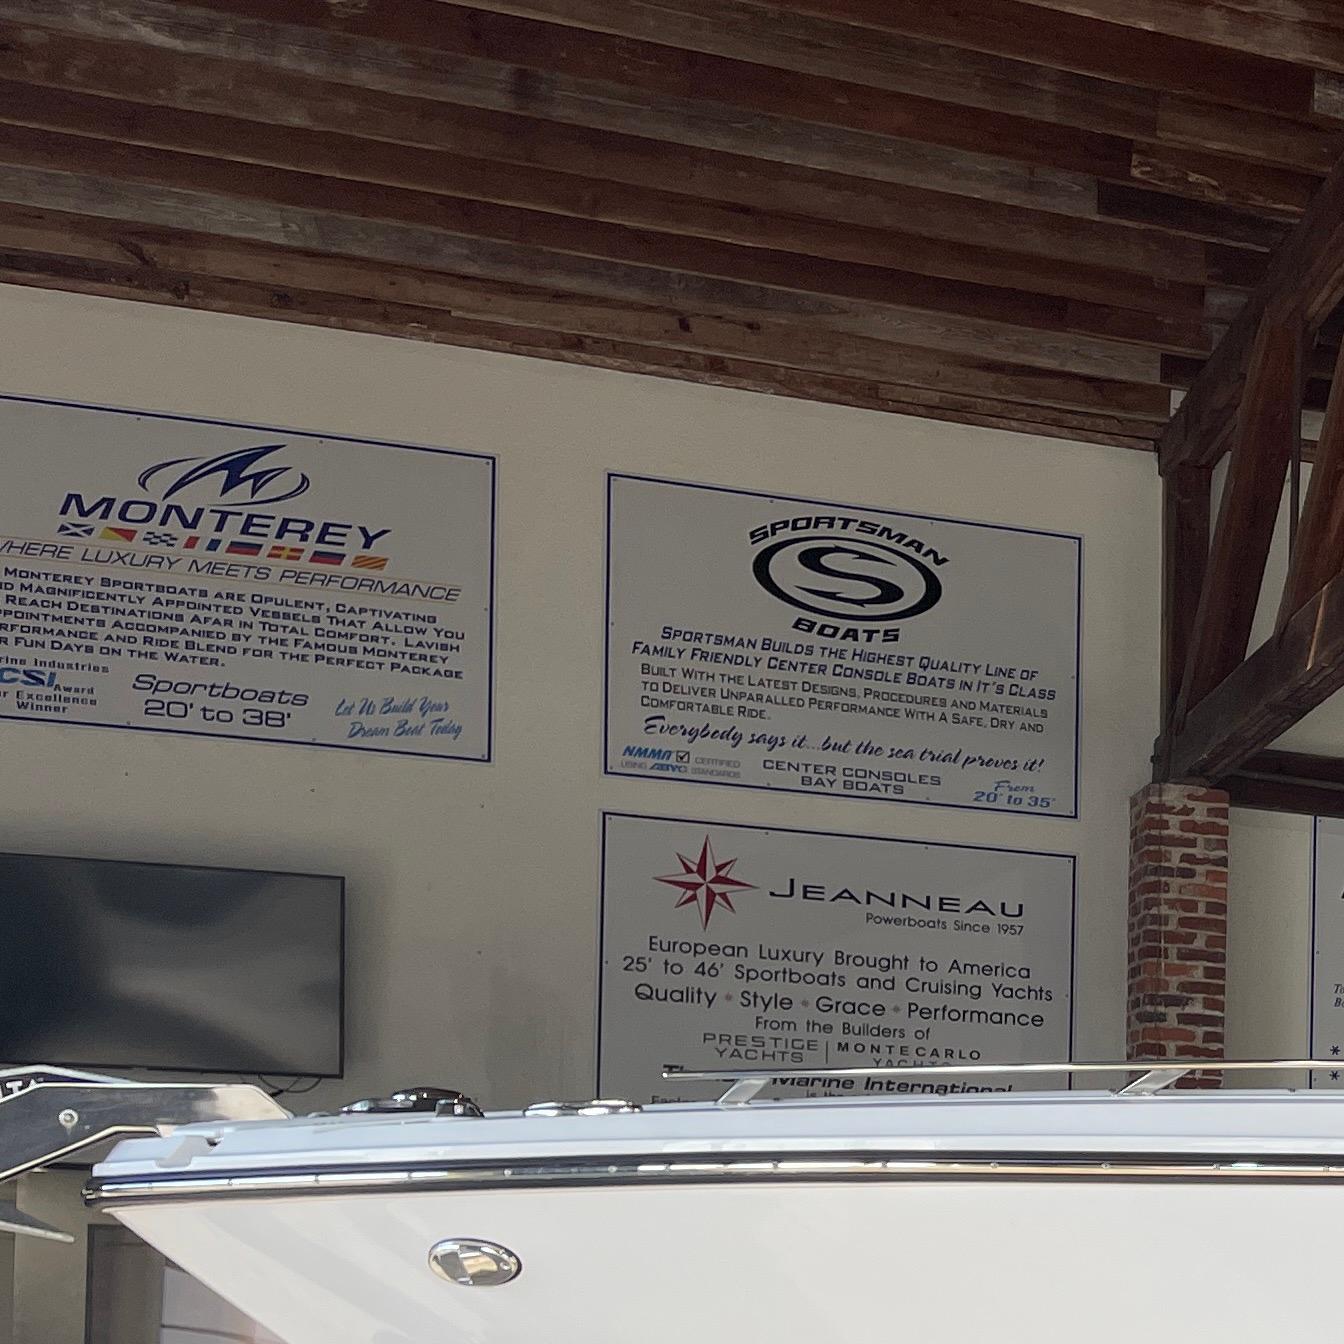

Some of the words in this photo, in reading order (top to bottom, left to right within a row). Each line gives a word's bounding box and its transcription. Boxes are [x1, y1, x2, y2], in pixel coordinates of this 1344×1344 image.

[58, 493, 392, 550] MONTEREY
[748, 516, 950, 568] SPORTSMAN
[80, 547, 182, 570] LUXURY
[187, 559, 271, 580] MEETS
[279, 569, 461, 601] PERFORMANCE
[792, 617, 901, 643] BOATS
[132, 673, 309, 706] Sportboats
[144, 700, 193, 718] 20'
[201, 706, 233, 725] to
[644, 715, 743, 748] Everybody
[747, 732, 786, 752] says
[762, 759, 836, 776] CENTER
[842, 767, 941, 785] CONSOLES
[800, 775, 836, 788] BAY
[842, 779, 903, 794] BOATS
[769, 878, 1025, 918] JEANNEAU
[865, 912, 947, 929] Powerboats
[953, 919, 990, 933] Since
[997, 923, 1024, 935] 1957
[649, 935, 748, 958] European
[759, 943, 824, 967] Luxury
[834, 949, 909, 972] Brought
[919, 956, 937, 972] to
[947, 958, 1030, 979] America
[622, 955, 651, 972] 25'
[663, 958, 683, 975] to
[694, 961, 723, 977] 46'
[734, 963, 845, 987] Sportboats
[856, 975, 895, 990] and
[905, 976, 981, 1000] Cruising
[991, 982, 1052, 1001] Yachts
[1333, 983, 1344, 994] To
[634, 982, 716, 1008] Quality
[739, 990, 793, 1012] Style
[815, 995, 885, 1016] Grace
[907, 1001, 1043, 1027] Performance
[702, 1032, 818, 1051] PRESTIGE
[755, 1015, 796, 1031] From
[806, 1019, 833, 1034] the
[842, 1021, 905, 1038] Builders
[914, 1026, 930, 1040] of
[714, 1047, 803, 1063] YACHTS
